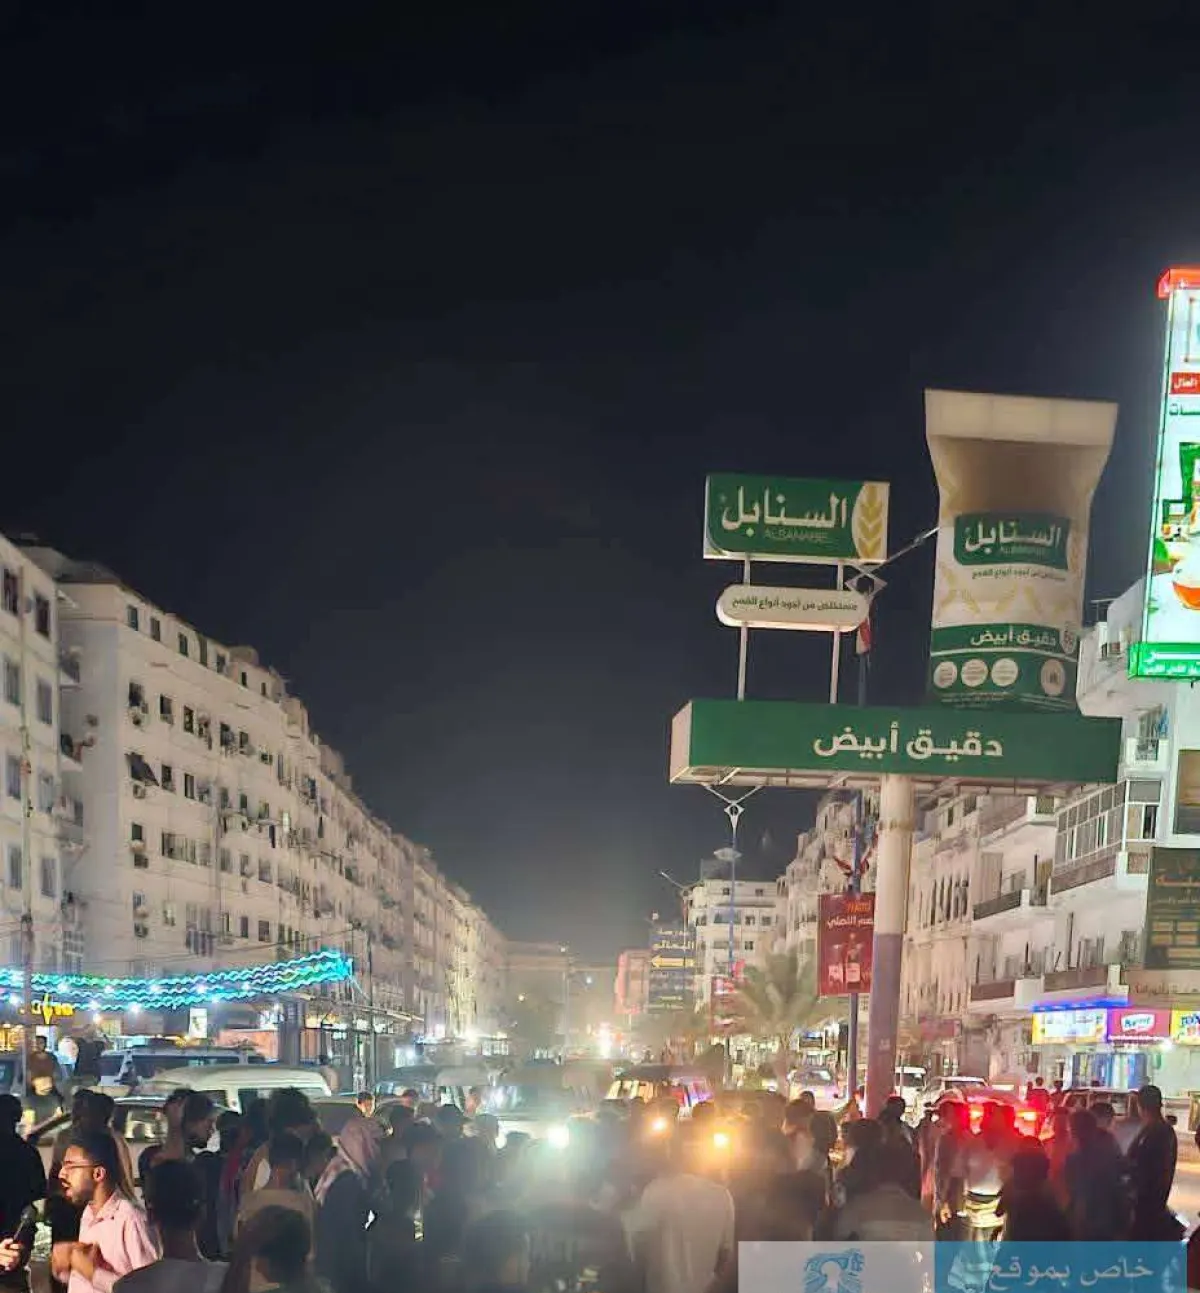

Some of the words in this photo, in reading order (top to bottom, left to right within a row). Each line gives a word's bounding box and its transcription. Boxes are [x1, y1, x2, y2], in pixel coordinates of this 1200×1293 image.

[722, 486, 847, 537] السنابل
[964, 520, 1061, 554] السنابل
[970, 625, 1014, 646] أبيض
[1016, 629, 1057, 646] دقيق
[813, 721, 899, 760] أبيض
[906, 728, 1004, 761] دقيق
